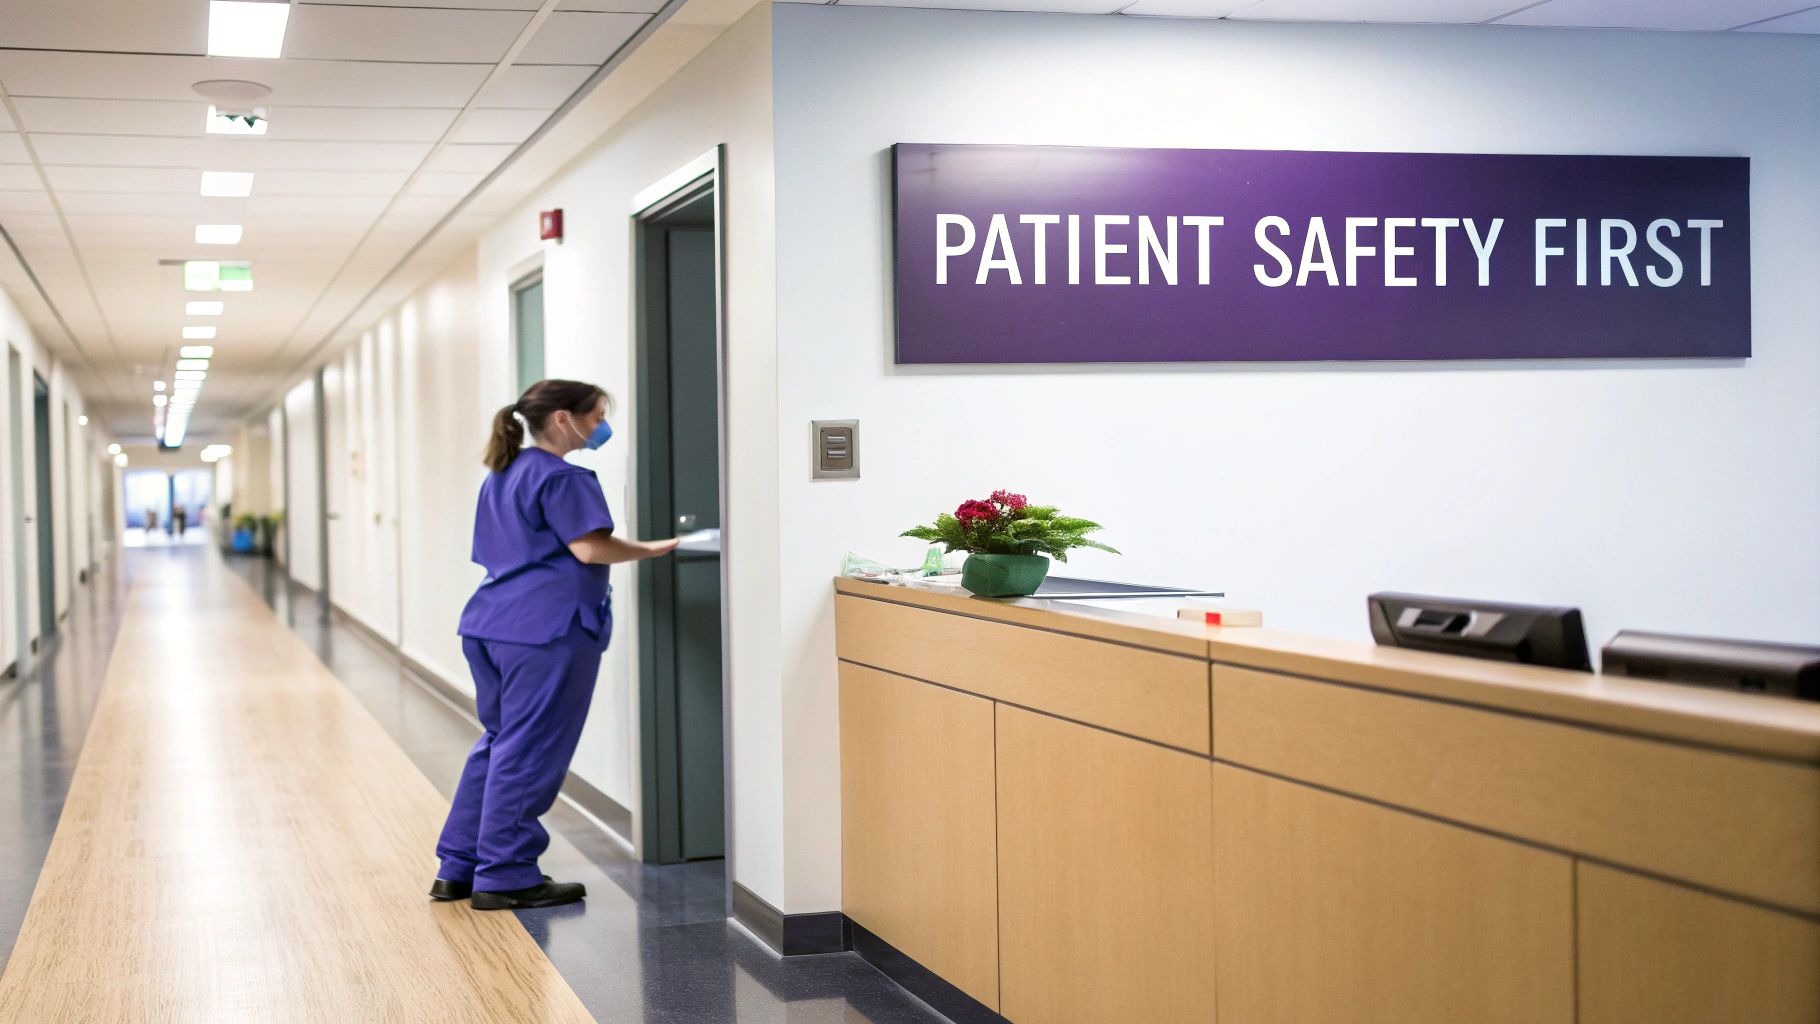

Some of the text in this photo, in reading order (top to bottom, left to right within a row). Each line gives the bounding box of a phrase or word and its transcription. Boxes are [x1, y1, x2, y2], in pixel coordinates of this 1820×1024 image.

[935, 213, 1724, 288] PATIENT SAFETY FIRST
